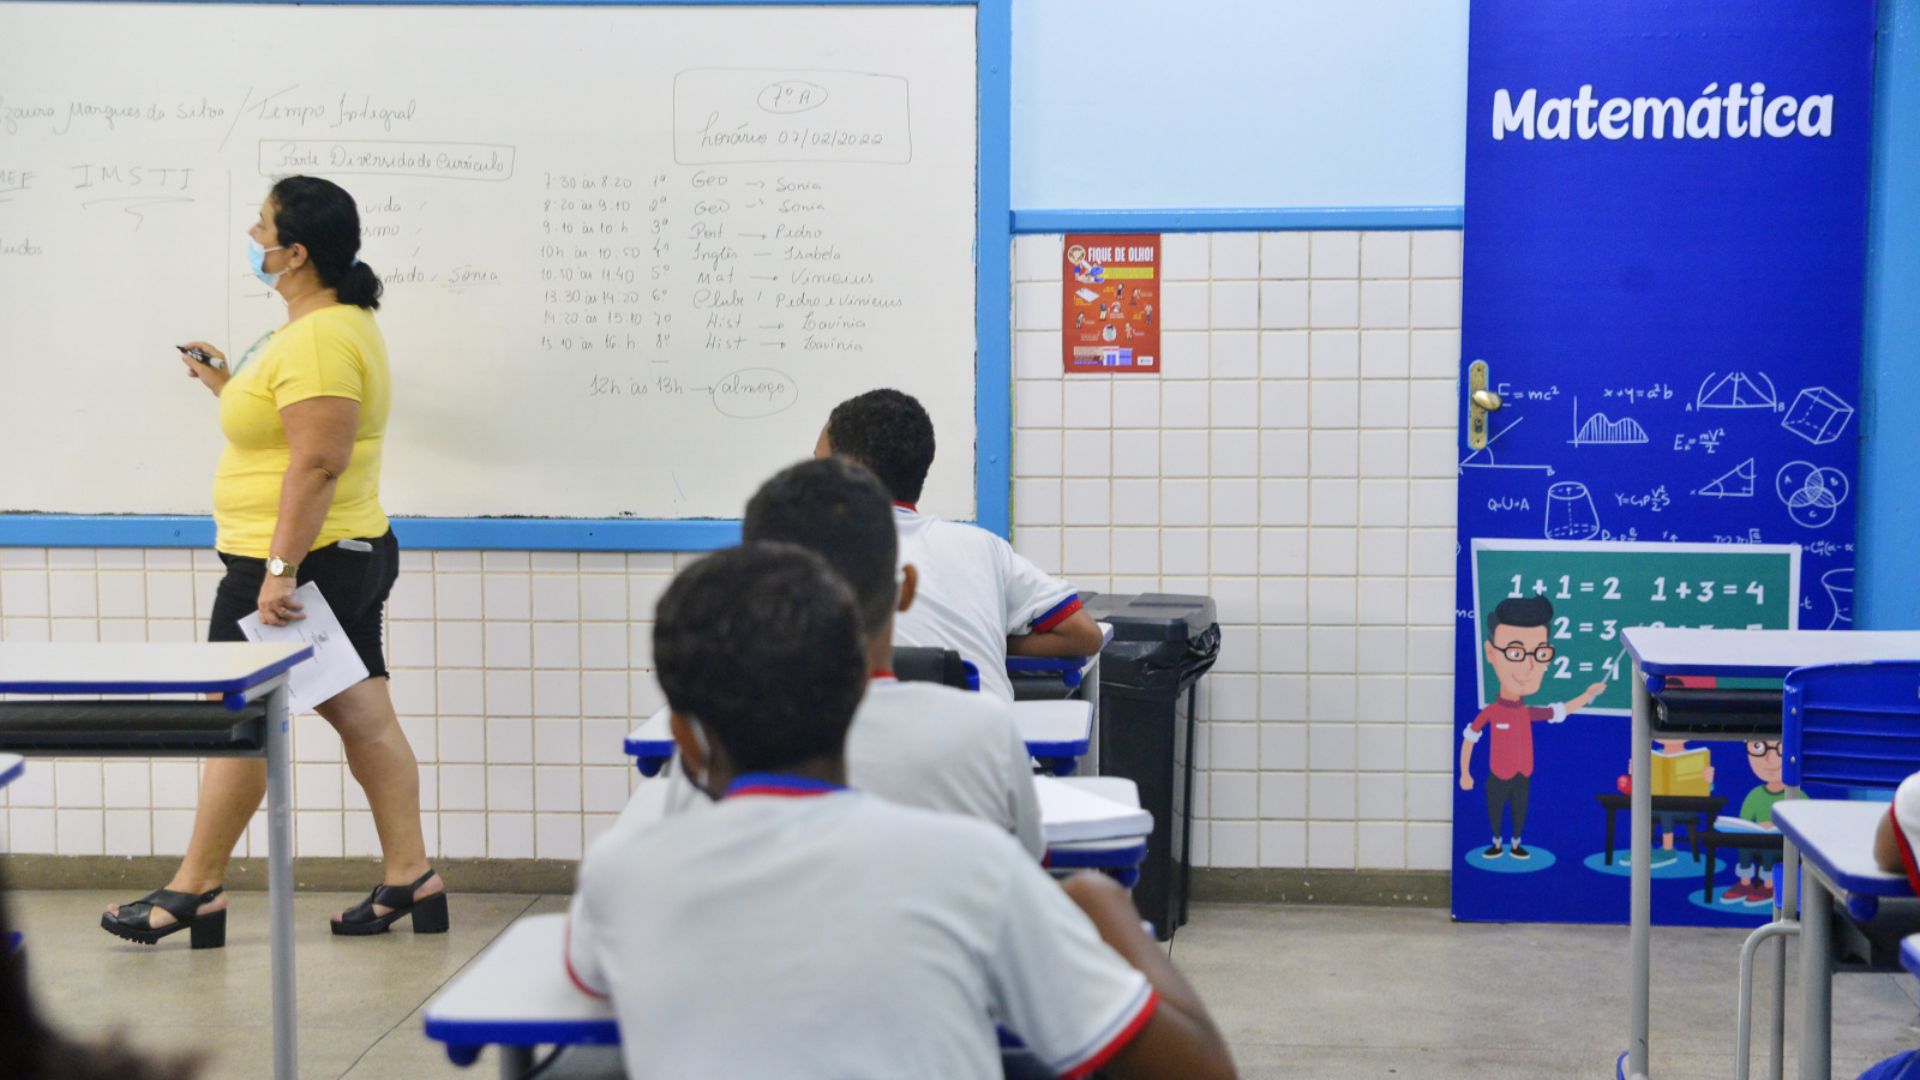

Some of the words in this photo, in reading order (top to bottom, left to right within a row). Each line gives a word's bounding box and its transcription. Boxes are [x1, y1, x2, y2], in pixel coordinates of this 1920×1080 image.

[0, 104, 55, 137] zaura
[1491, 81, 1834, 141] Matemática
[1088, 246, 1112, 264] FIQUE
[1114, 246, 1126, 262] DE
